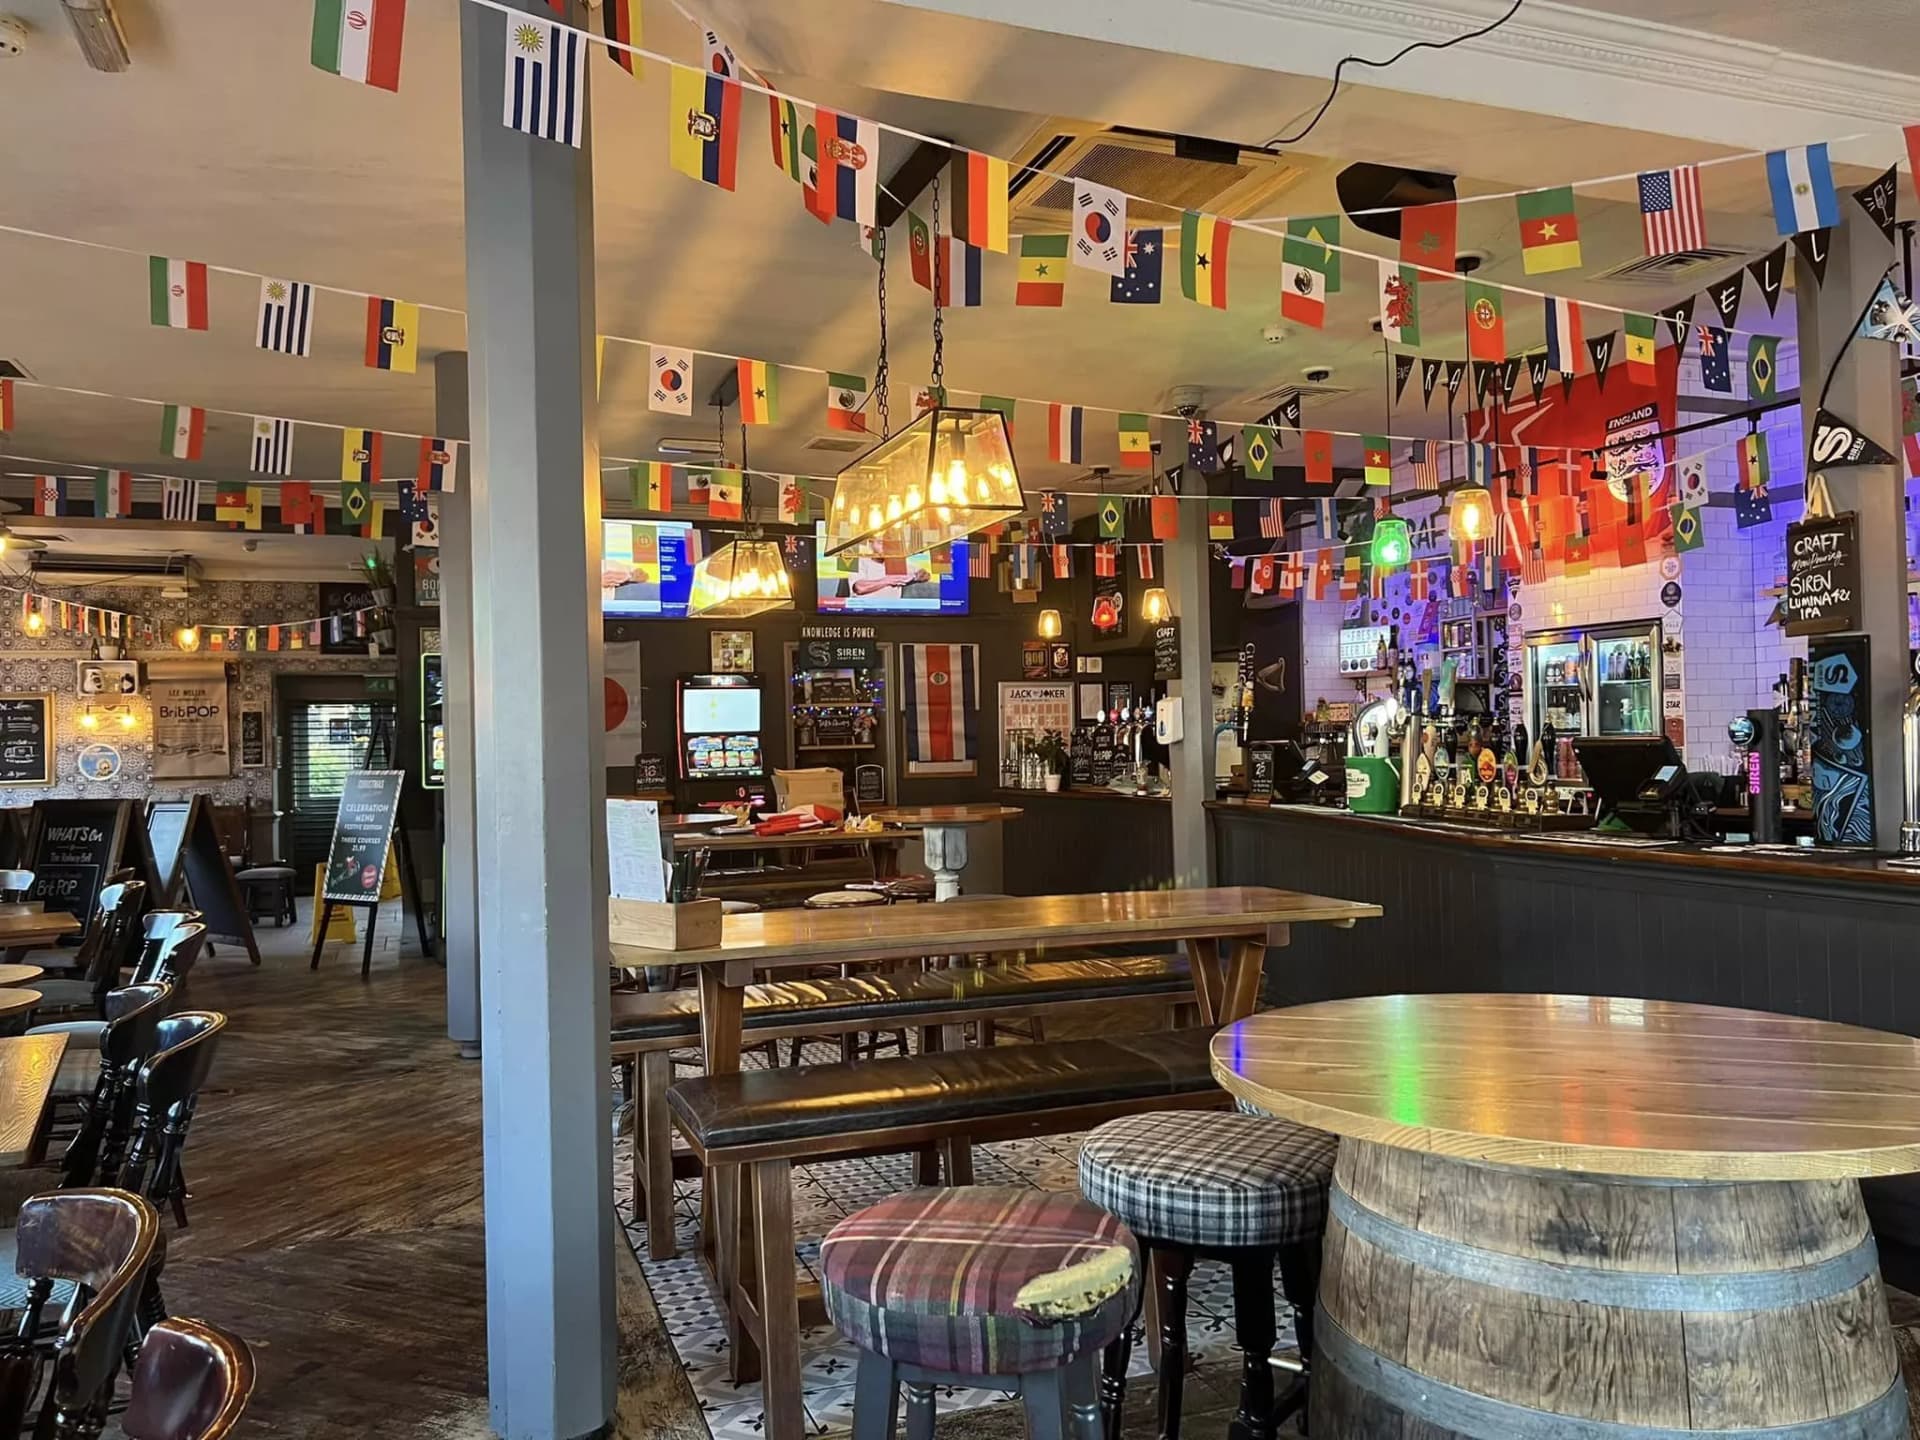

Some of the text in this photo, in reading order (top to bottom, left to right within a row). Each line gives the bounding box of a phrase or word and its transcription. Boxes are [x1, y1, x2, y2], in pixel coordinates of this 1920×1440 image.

[1608, 407, 1653, 429] ENGLAND
[1794, 533, 1846, 556] CRAFT
[1790, 569, 1832, 596] SIREN
[1789, 591, 1832, 610] LUMINA
[1800, 607, 1822, 621] IPA
[802, 627, 841, 638] KNOWLEDGE
[843, 627, 850, 637] IS
[836, 647, 866, 657] SIREN
[1010, 689, 1032, 699] JACK
[160, 705, 220, 719] BritPOP
[1665, 701, 1680, 709] STAR
[1749, 752, 1760, 794] SIREN
[345, 803, 389, 813] CELEBRATION
[355, 814, 376, 823] MENU
